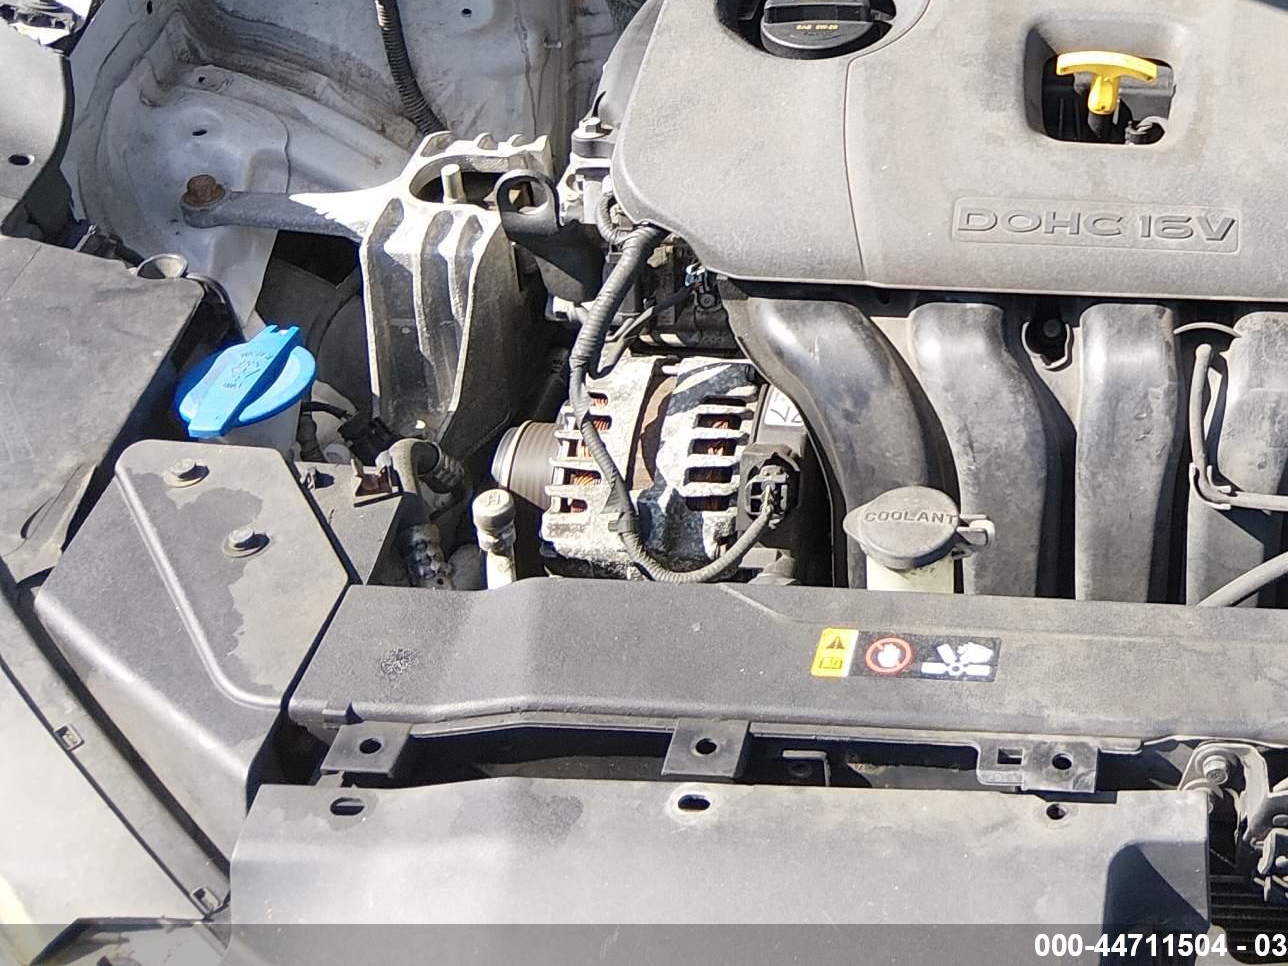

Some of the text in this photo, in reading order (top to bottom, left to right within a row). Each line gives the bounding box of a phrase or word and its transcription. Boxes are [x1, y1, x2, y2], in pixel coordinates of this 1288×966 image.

[957, 207, 1236, 241] DOHC 16V
[863, 510, 958, 525] COOLANT
